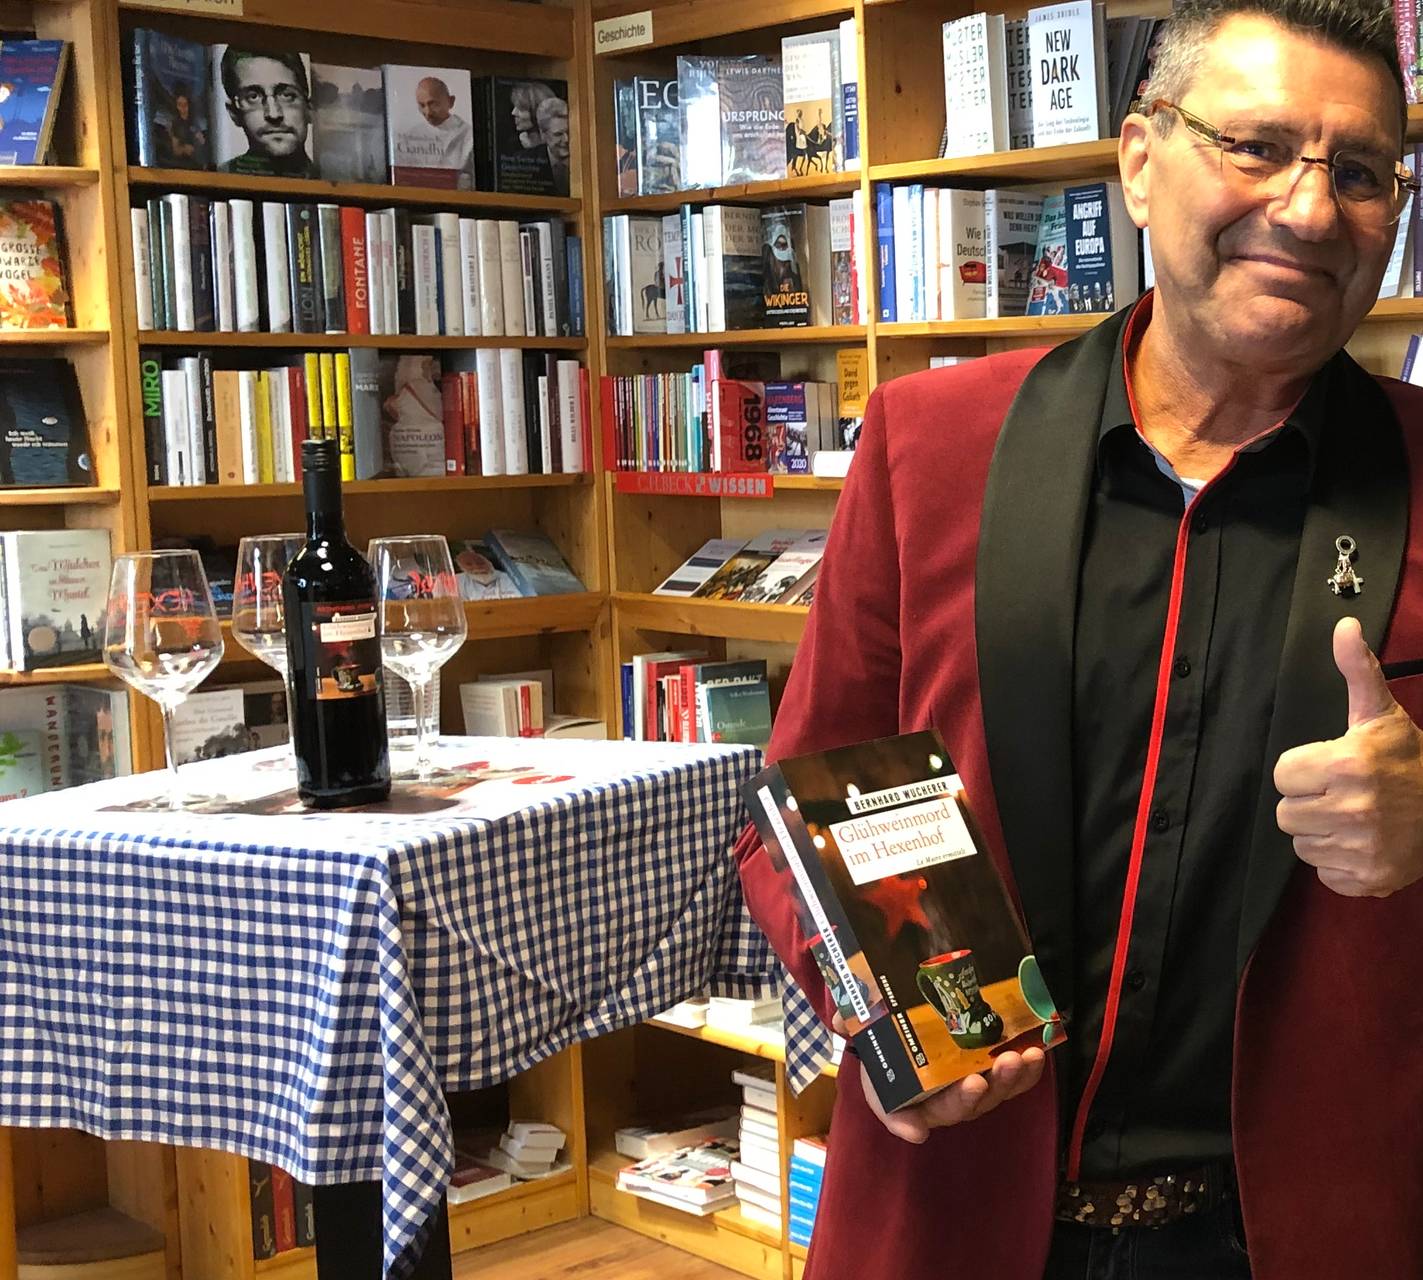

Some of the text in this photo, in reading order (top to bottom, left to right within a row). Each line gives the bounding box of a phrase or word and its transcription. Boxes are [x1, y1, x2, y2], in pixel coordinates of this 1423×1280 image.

[597, 23, 647, 45] Geschichte
[1045, 28, 1072, 54] NEW
[1040, 54, 1081, 86] DARK
[1050, 87, 1073, 111] AGE
[1073, 200, 1103, 221] ANGRIFF
[965, 226, 982, 240] Wie
[1082, 219, 1097, 238] AUF
[1074, 236, 1105, 256] EUROPA
[352, 236, 368, 309] FONTANE
[763, 292, 810, 308] WIKINGER
[393, 433, 443, 443] NAPOLEON
[743, 393, 763, 462] 1968
[791, 457, 807, 469] 2020
[708, 476, 767, 496] WISSEN
[853, 780, 949, 811] BERNHARD WUCHERER
[837, 802, 952, 844] Glühweinmord
[846, 825, 946, 866] im Hexenhof
[822, 927, 867, 1018] BERNHARD WUCHERER
[896, 1012, 919, 1053] GMEINER
[867, 1028, 889, 1069] GMEINER
